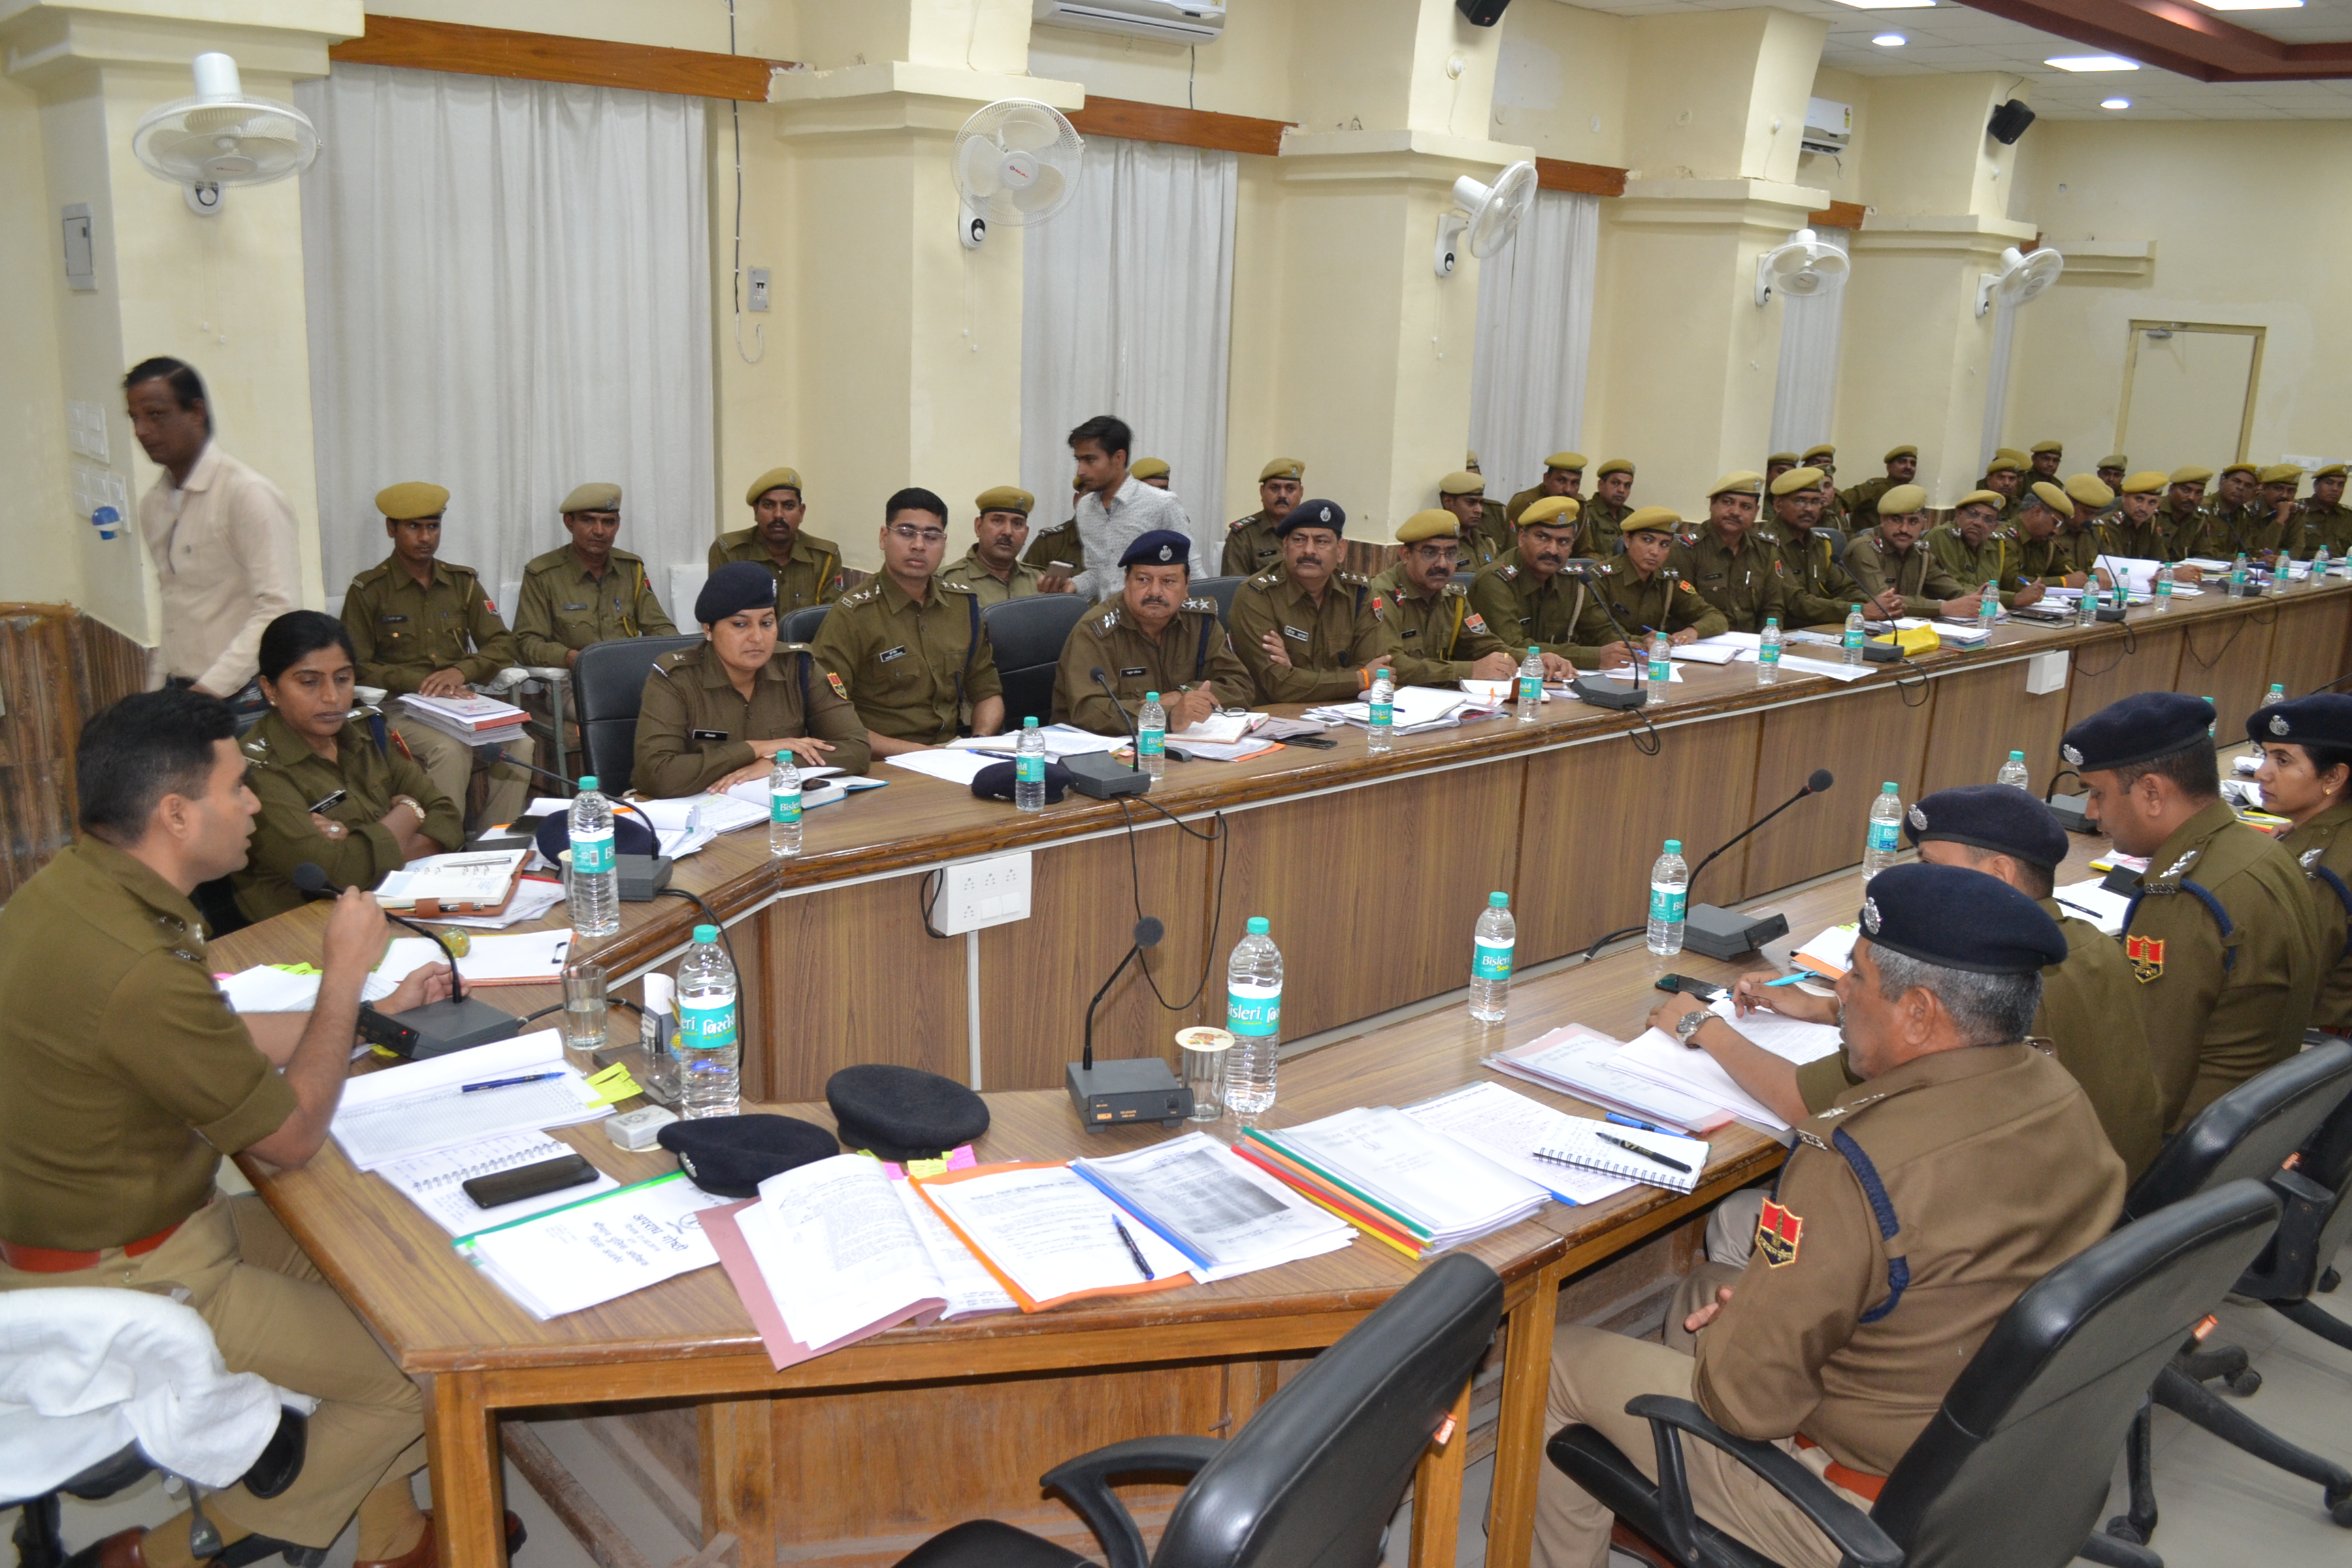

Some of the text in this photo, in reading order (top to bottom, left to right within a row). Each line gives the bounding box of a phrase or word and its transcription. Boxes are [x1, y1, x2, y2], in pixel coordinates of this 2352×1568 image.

[1482, 954, 1511, 966] Bisleri
[1624, 1141, 1639, 1150] V7
[633, 1213, 689, 1252] अपराध गोष्ठी
[605, 1235, 629, 1251] पुलिस
